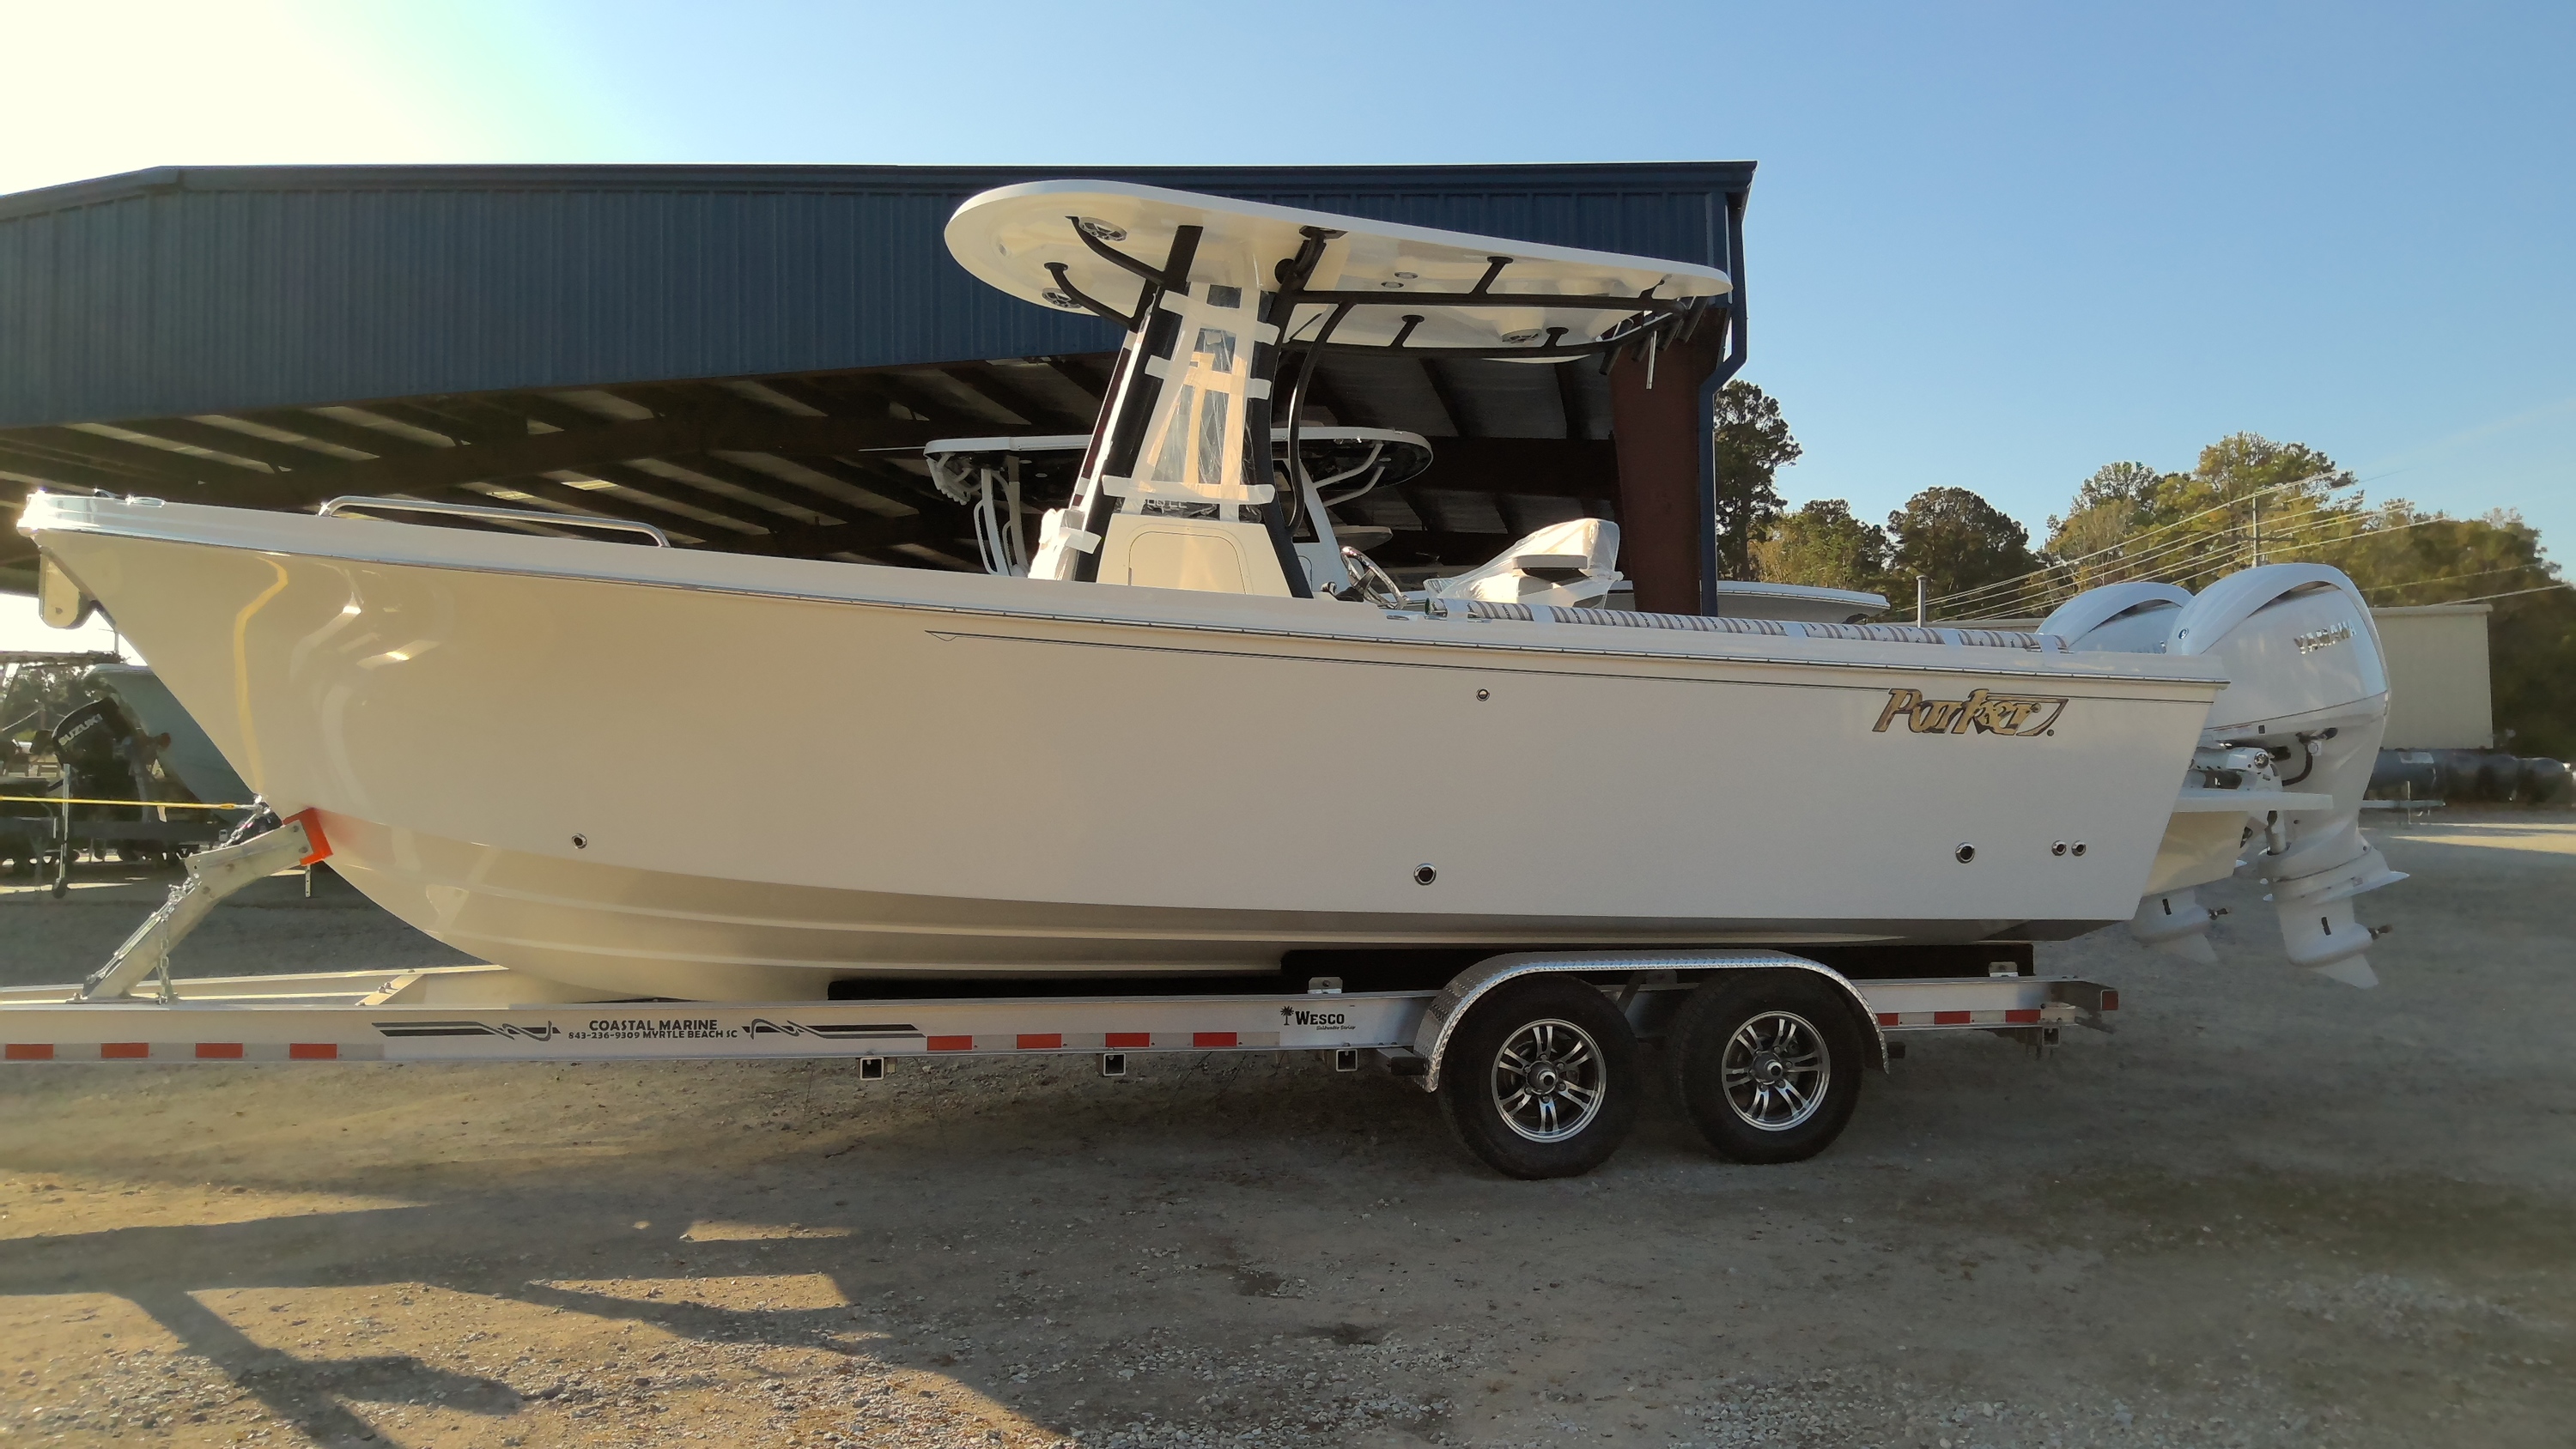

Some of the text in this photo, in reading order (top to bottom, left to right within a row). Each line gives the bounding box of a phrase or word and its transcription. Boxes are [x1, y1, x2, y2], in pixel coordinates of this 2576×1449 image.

[2293, 619, 2357, 655] YAMAHA
[1872, 688, 2044, 736] Parker
[58, 712, 103, 746] SUZUKI
[589, 1019, 718, 1032] COASTAL MARINE
[1295, 1010, 1346, 1026] WESCO
[568, 1029, 738, 1040] 843-236-9309 MYRTLE BEACH SC
